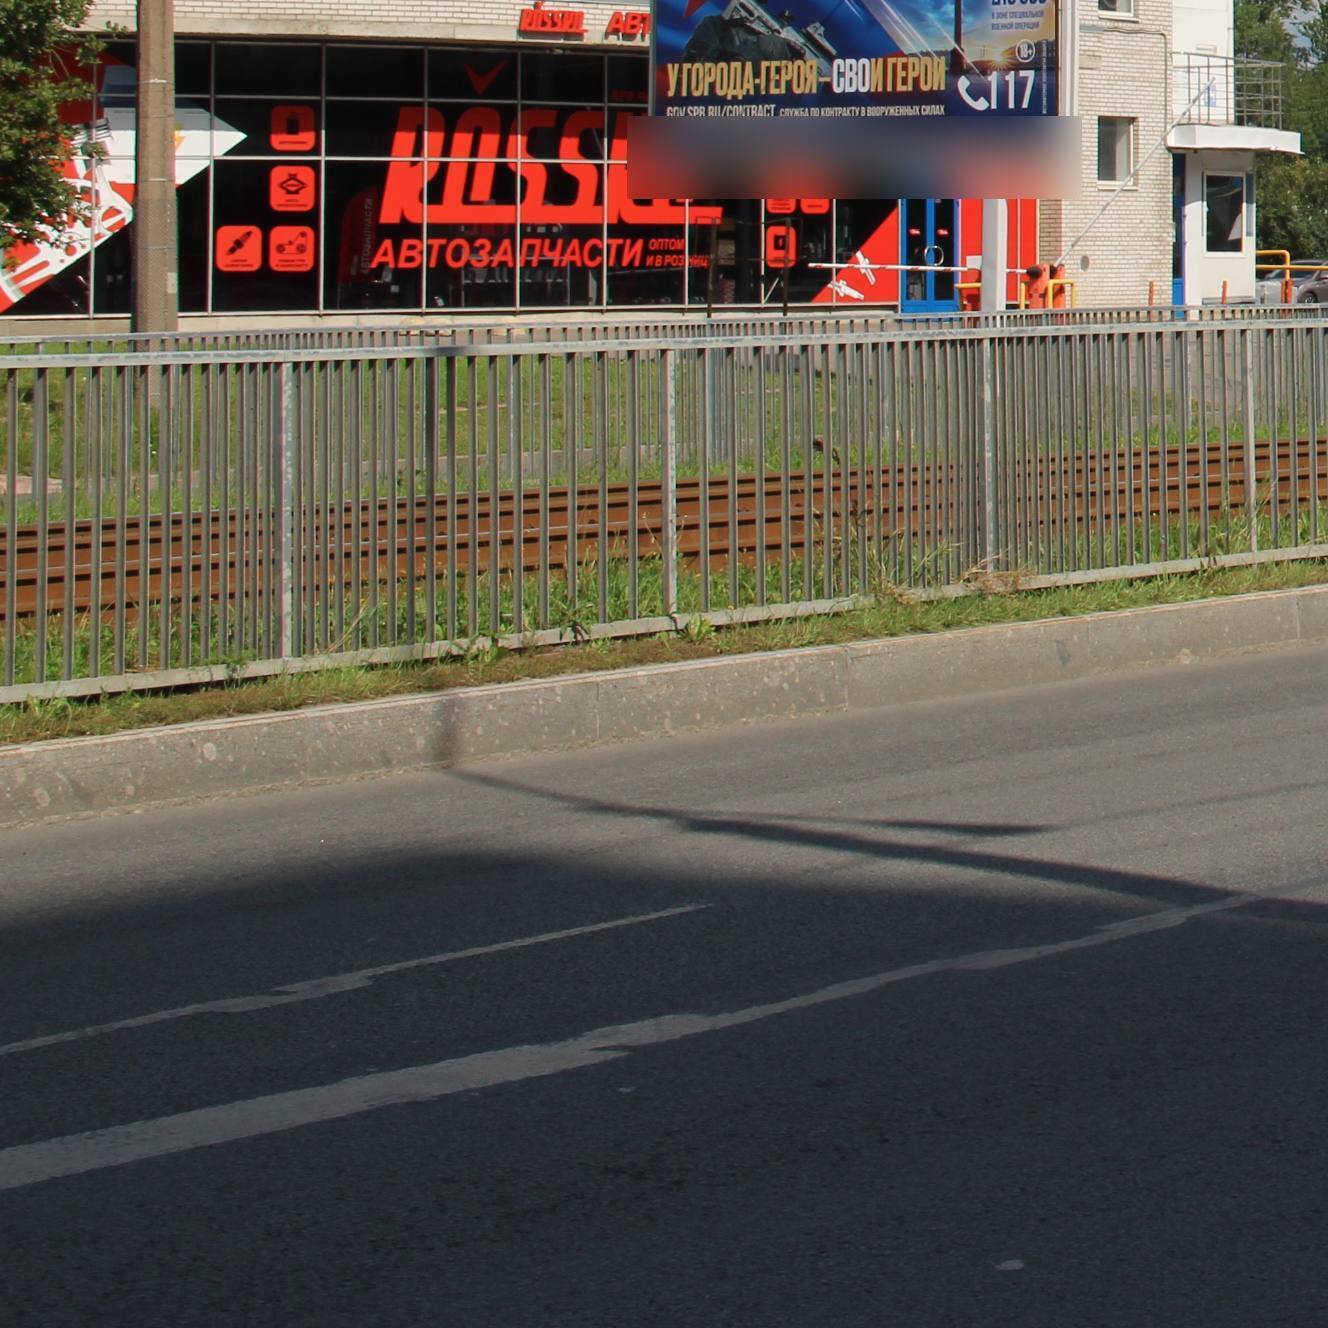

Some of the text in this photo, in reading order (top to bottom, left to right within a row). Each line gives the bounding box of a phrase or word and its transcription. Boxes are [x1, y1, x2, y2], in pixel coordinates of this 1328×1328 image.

[667, 63, 679, 97] У
[681, 59, 817, 101] ГОРОДА-ГЕРОЯ
[832, 57, 883, 93] СВОИ
[987, 70, 1035, 110] 117
[821, 106, 859, 117] КОНТРАКТУ
[861, 106, 866, 117] В
[867, 105, 920, 117] ВООРУЖЕННЫХ
[921, 104, 945, 116] СИЛАХ
[380, 106, 722, 224] ROSS
[370, 238, 645, 269] АВТОЗАПЧАСТИ
[649, 239, 685, 250] ОПТОМ
